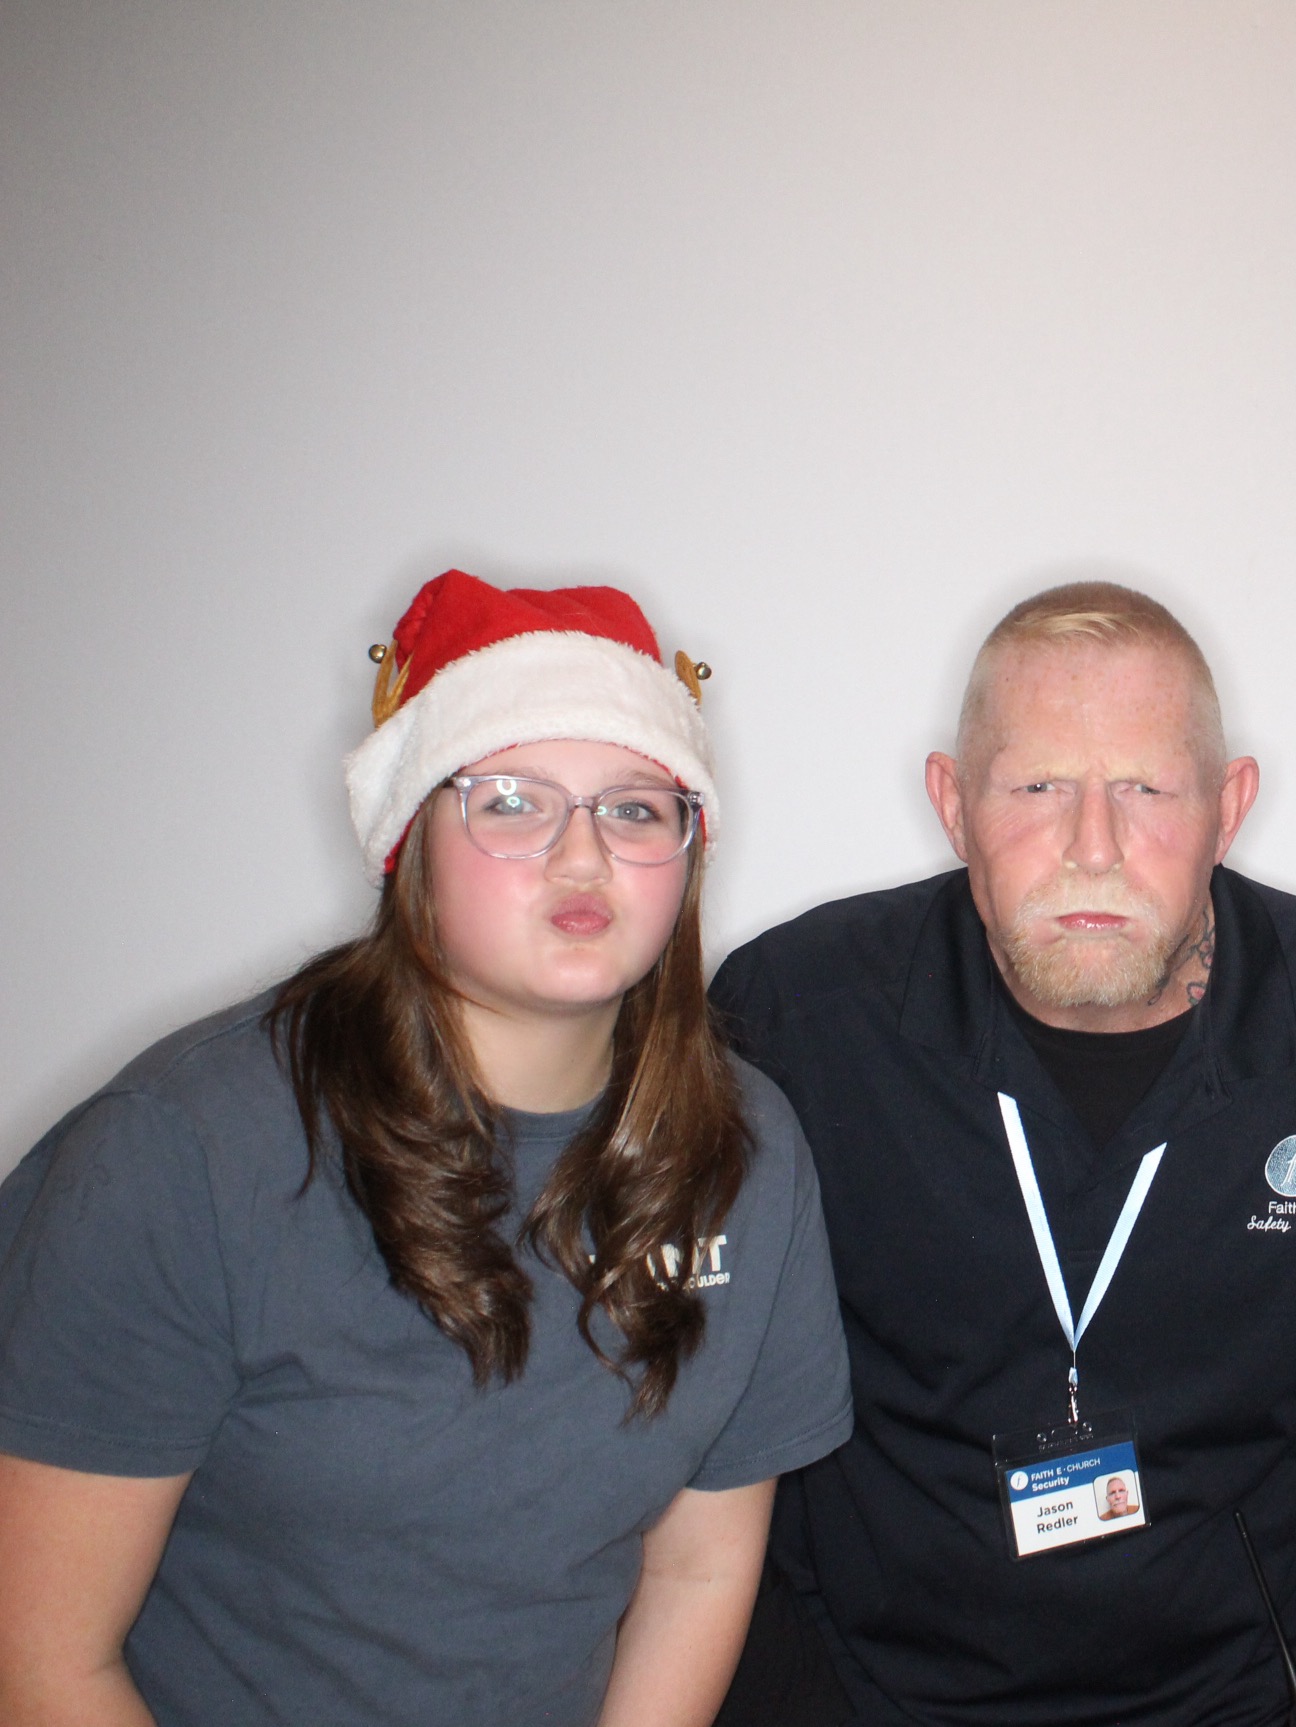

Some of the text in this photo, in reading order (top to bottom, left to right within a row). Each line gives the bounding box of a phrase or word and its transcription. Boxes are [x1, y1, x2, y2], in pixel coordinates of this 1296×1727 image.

[1246, 1214, 1292, 1233] Safety
[1030, 1457, 1101, 1482] FAITH E CHURCH
[1031, 1476, 1070, 1492] Security
[1037, 1501, 1074, 1518] Jason
[1036, 1516, 1078, 1534] Redler
